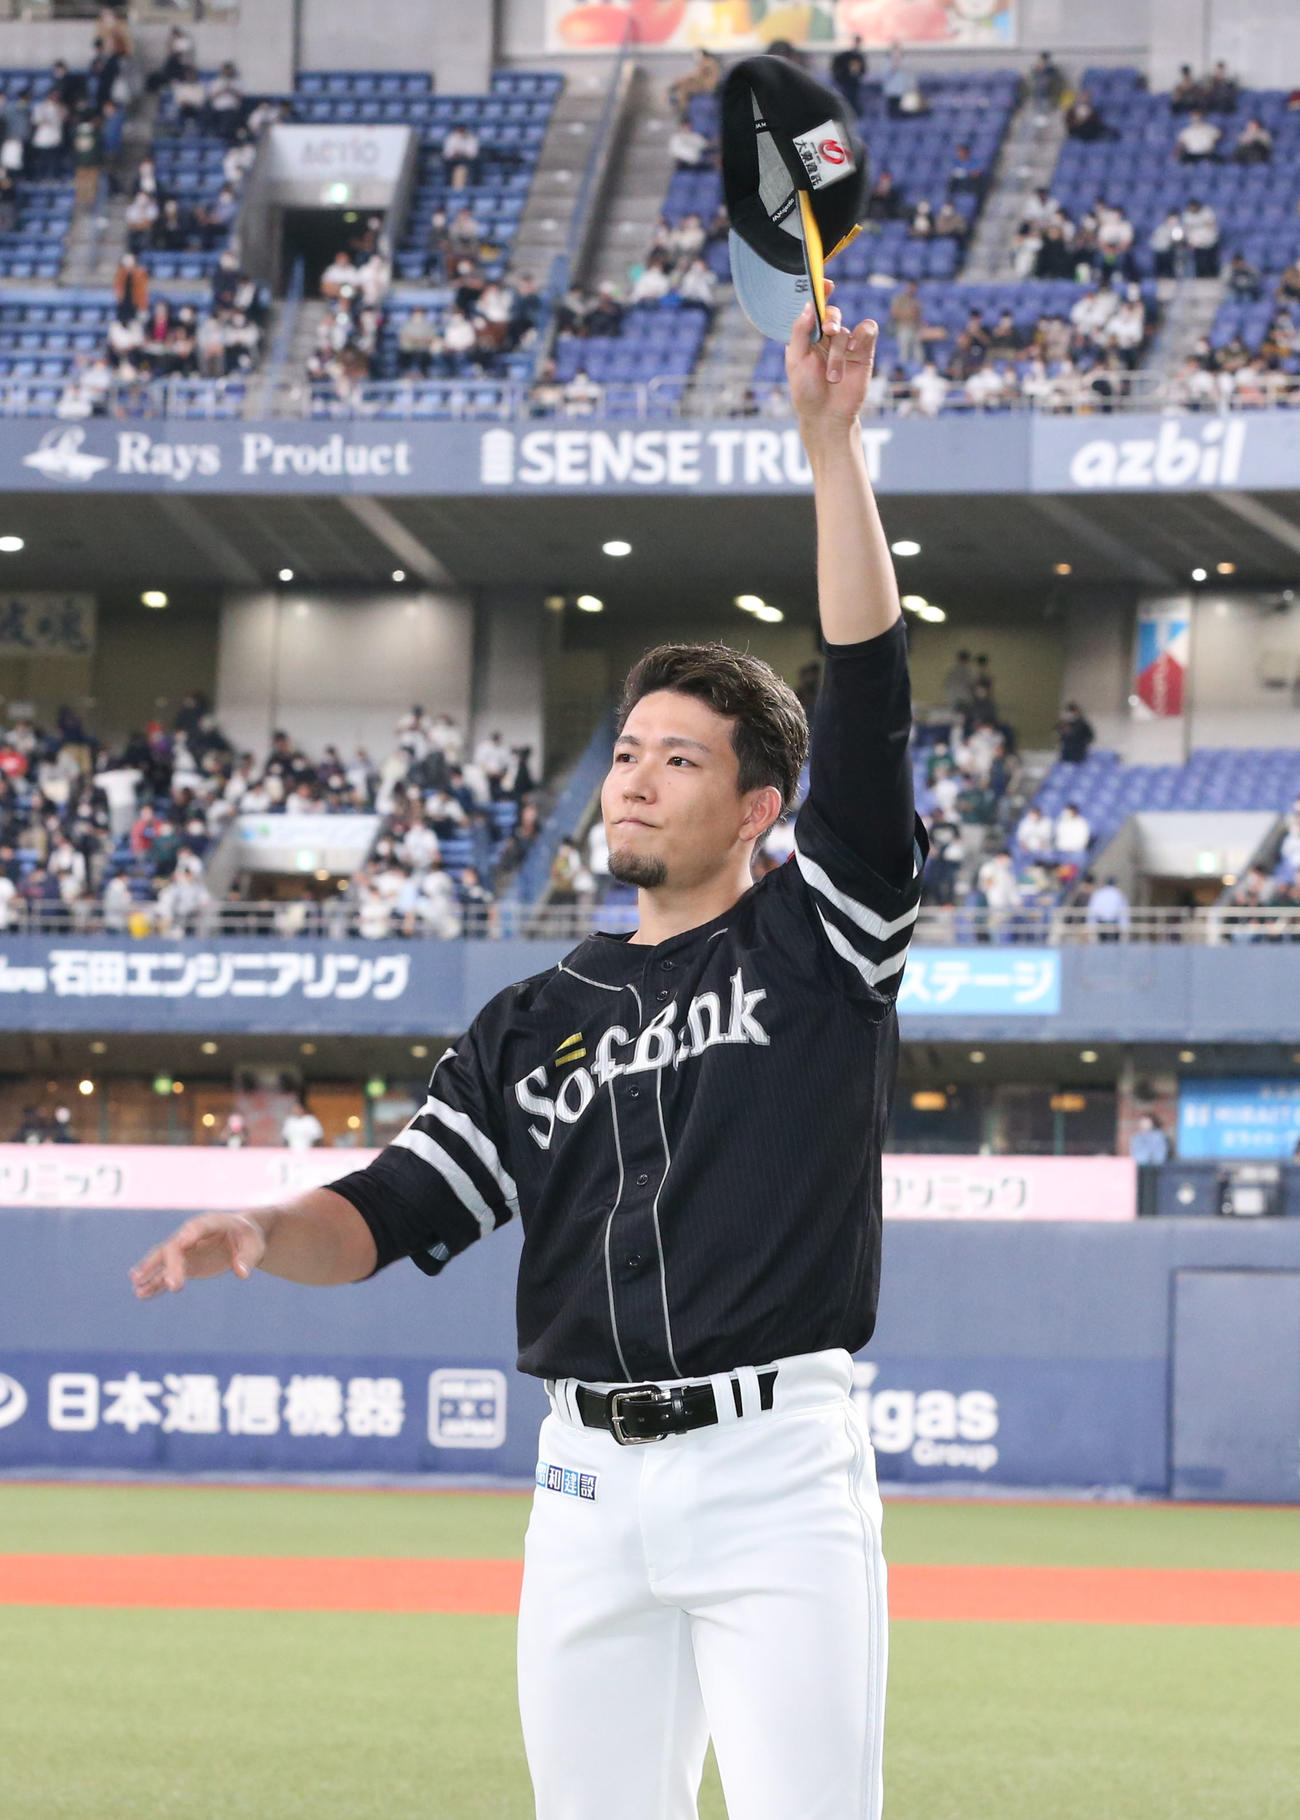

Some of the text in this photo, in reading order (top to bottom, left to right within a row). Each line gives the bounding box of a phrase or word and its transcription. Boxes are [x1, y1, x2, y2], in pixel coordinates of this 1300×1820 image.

[116, 431, 411, 481] Rays Product
[518, 429, 892, 485] SENSE TRUT
[1069, 418, 1247, 487] azbil
[49, 950, 411, 1000] 石田エンジニアリング
[898, 960, 1055, 1004] ステージ
[514, 966, 771, 1150] SofBnk
[48, 1371, 405, 1437] 日本通信機器
[912, 1438, 999, 1473] Group
